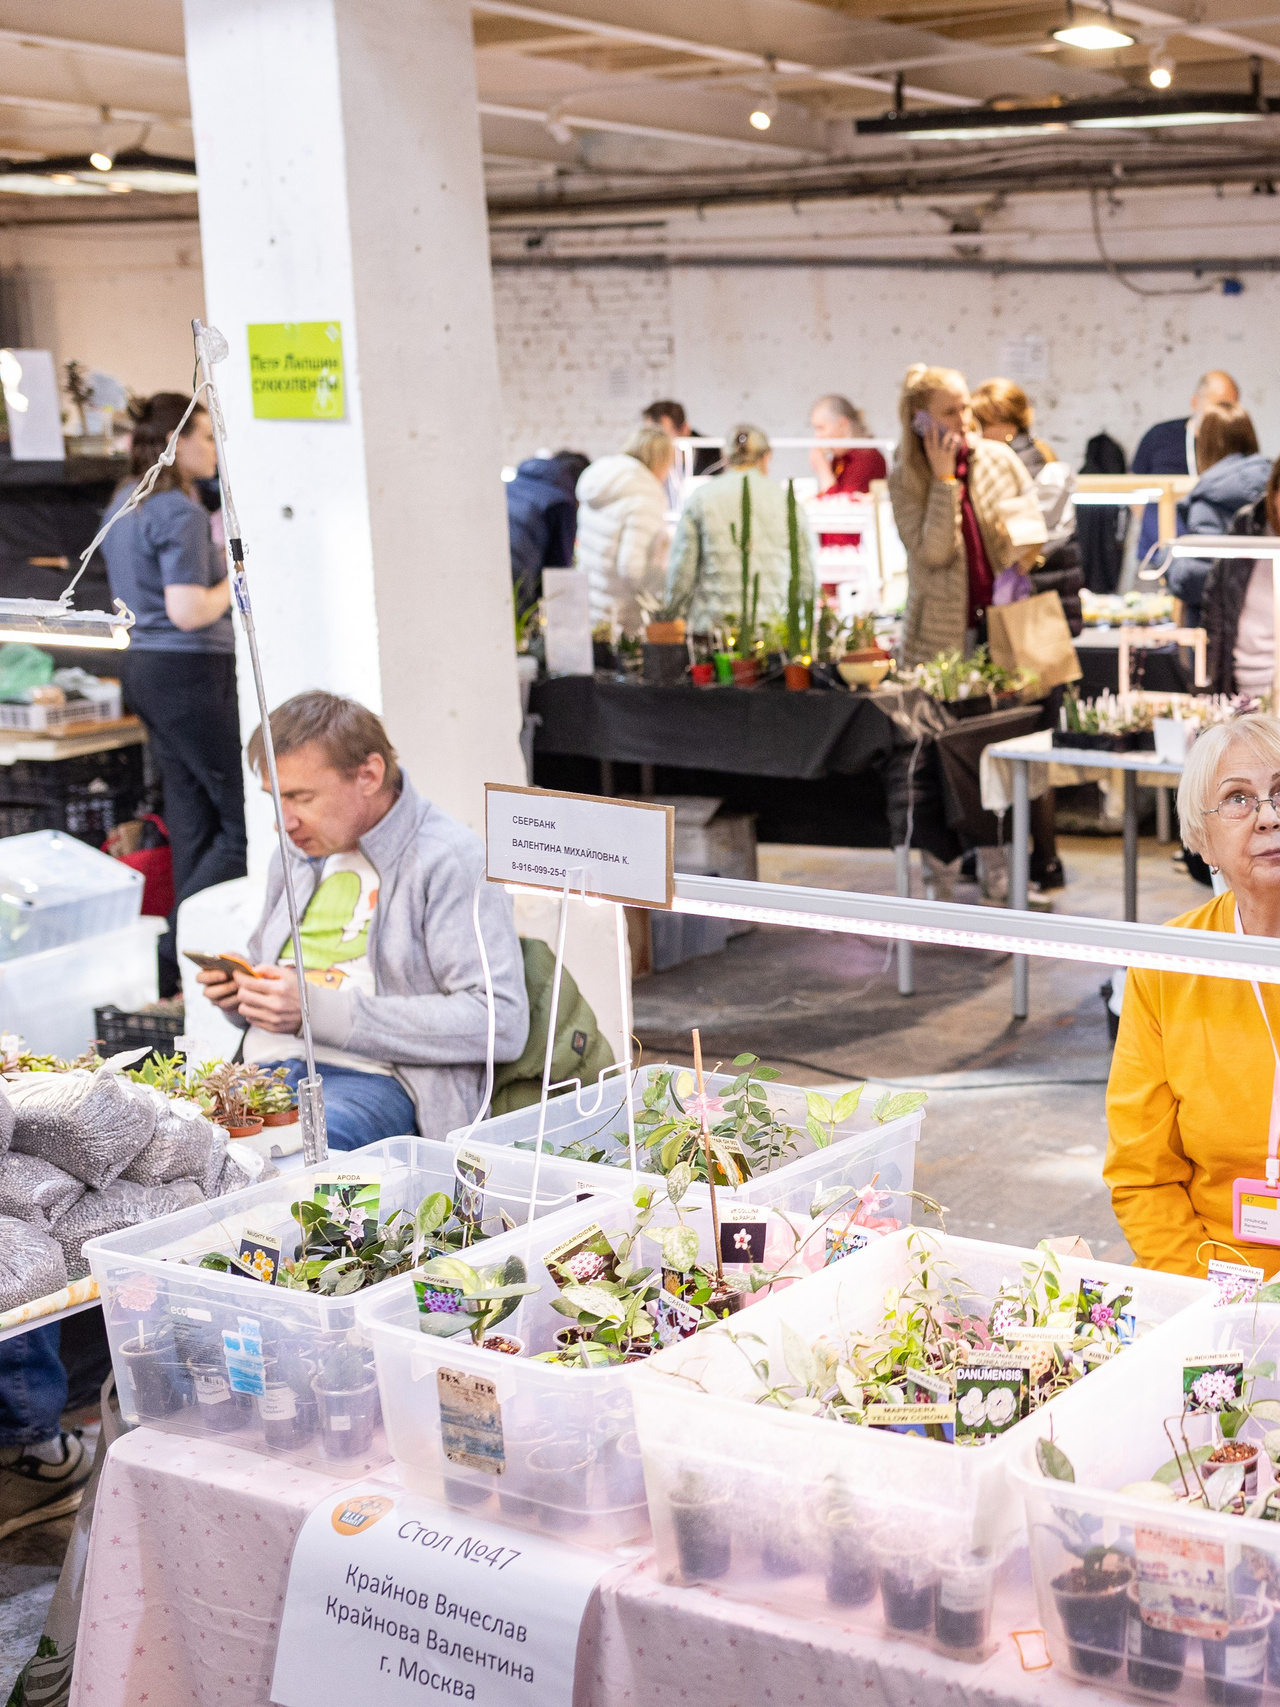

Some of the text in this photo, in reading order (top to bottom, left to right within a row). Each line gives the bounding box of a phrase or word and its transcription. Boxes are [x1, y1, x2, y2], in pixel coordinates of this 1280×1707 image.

[512, 815, 556, 830] СБЕРБАНК
[512, 838, 630, 865] ВАЛЕНТИНА МИХАЙЛОВНА К.
[512, 861, 567, 878] 8-916-099-25-0
[1245, 1196, 1254, 1204] 47
[266, 1236, 277, 1244] NOEL
[543, 1223, 598, 1261] NUMMULARIOIDES
[957, 1368, 1023, 1382] DANUMENSIS
[872, 1413, 950, 1422] YELLOW CORONA
[397, 1519, 522, 1571] Стол №47
[345, 1563, 528, 1644] Крайнов Вячеслав
[325, 1595, 534, 1684] Крайнова Валентина
[379, 1654, 476, 1700] г. Москва
